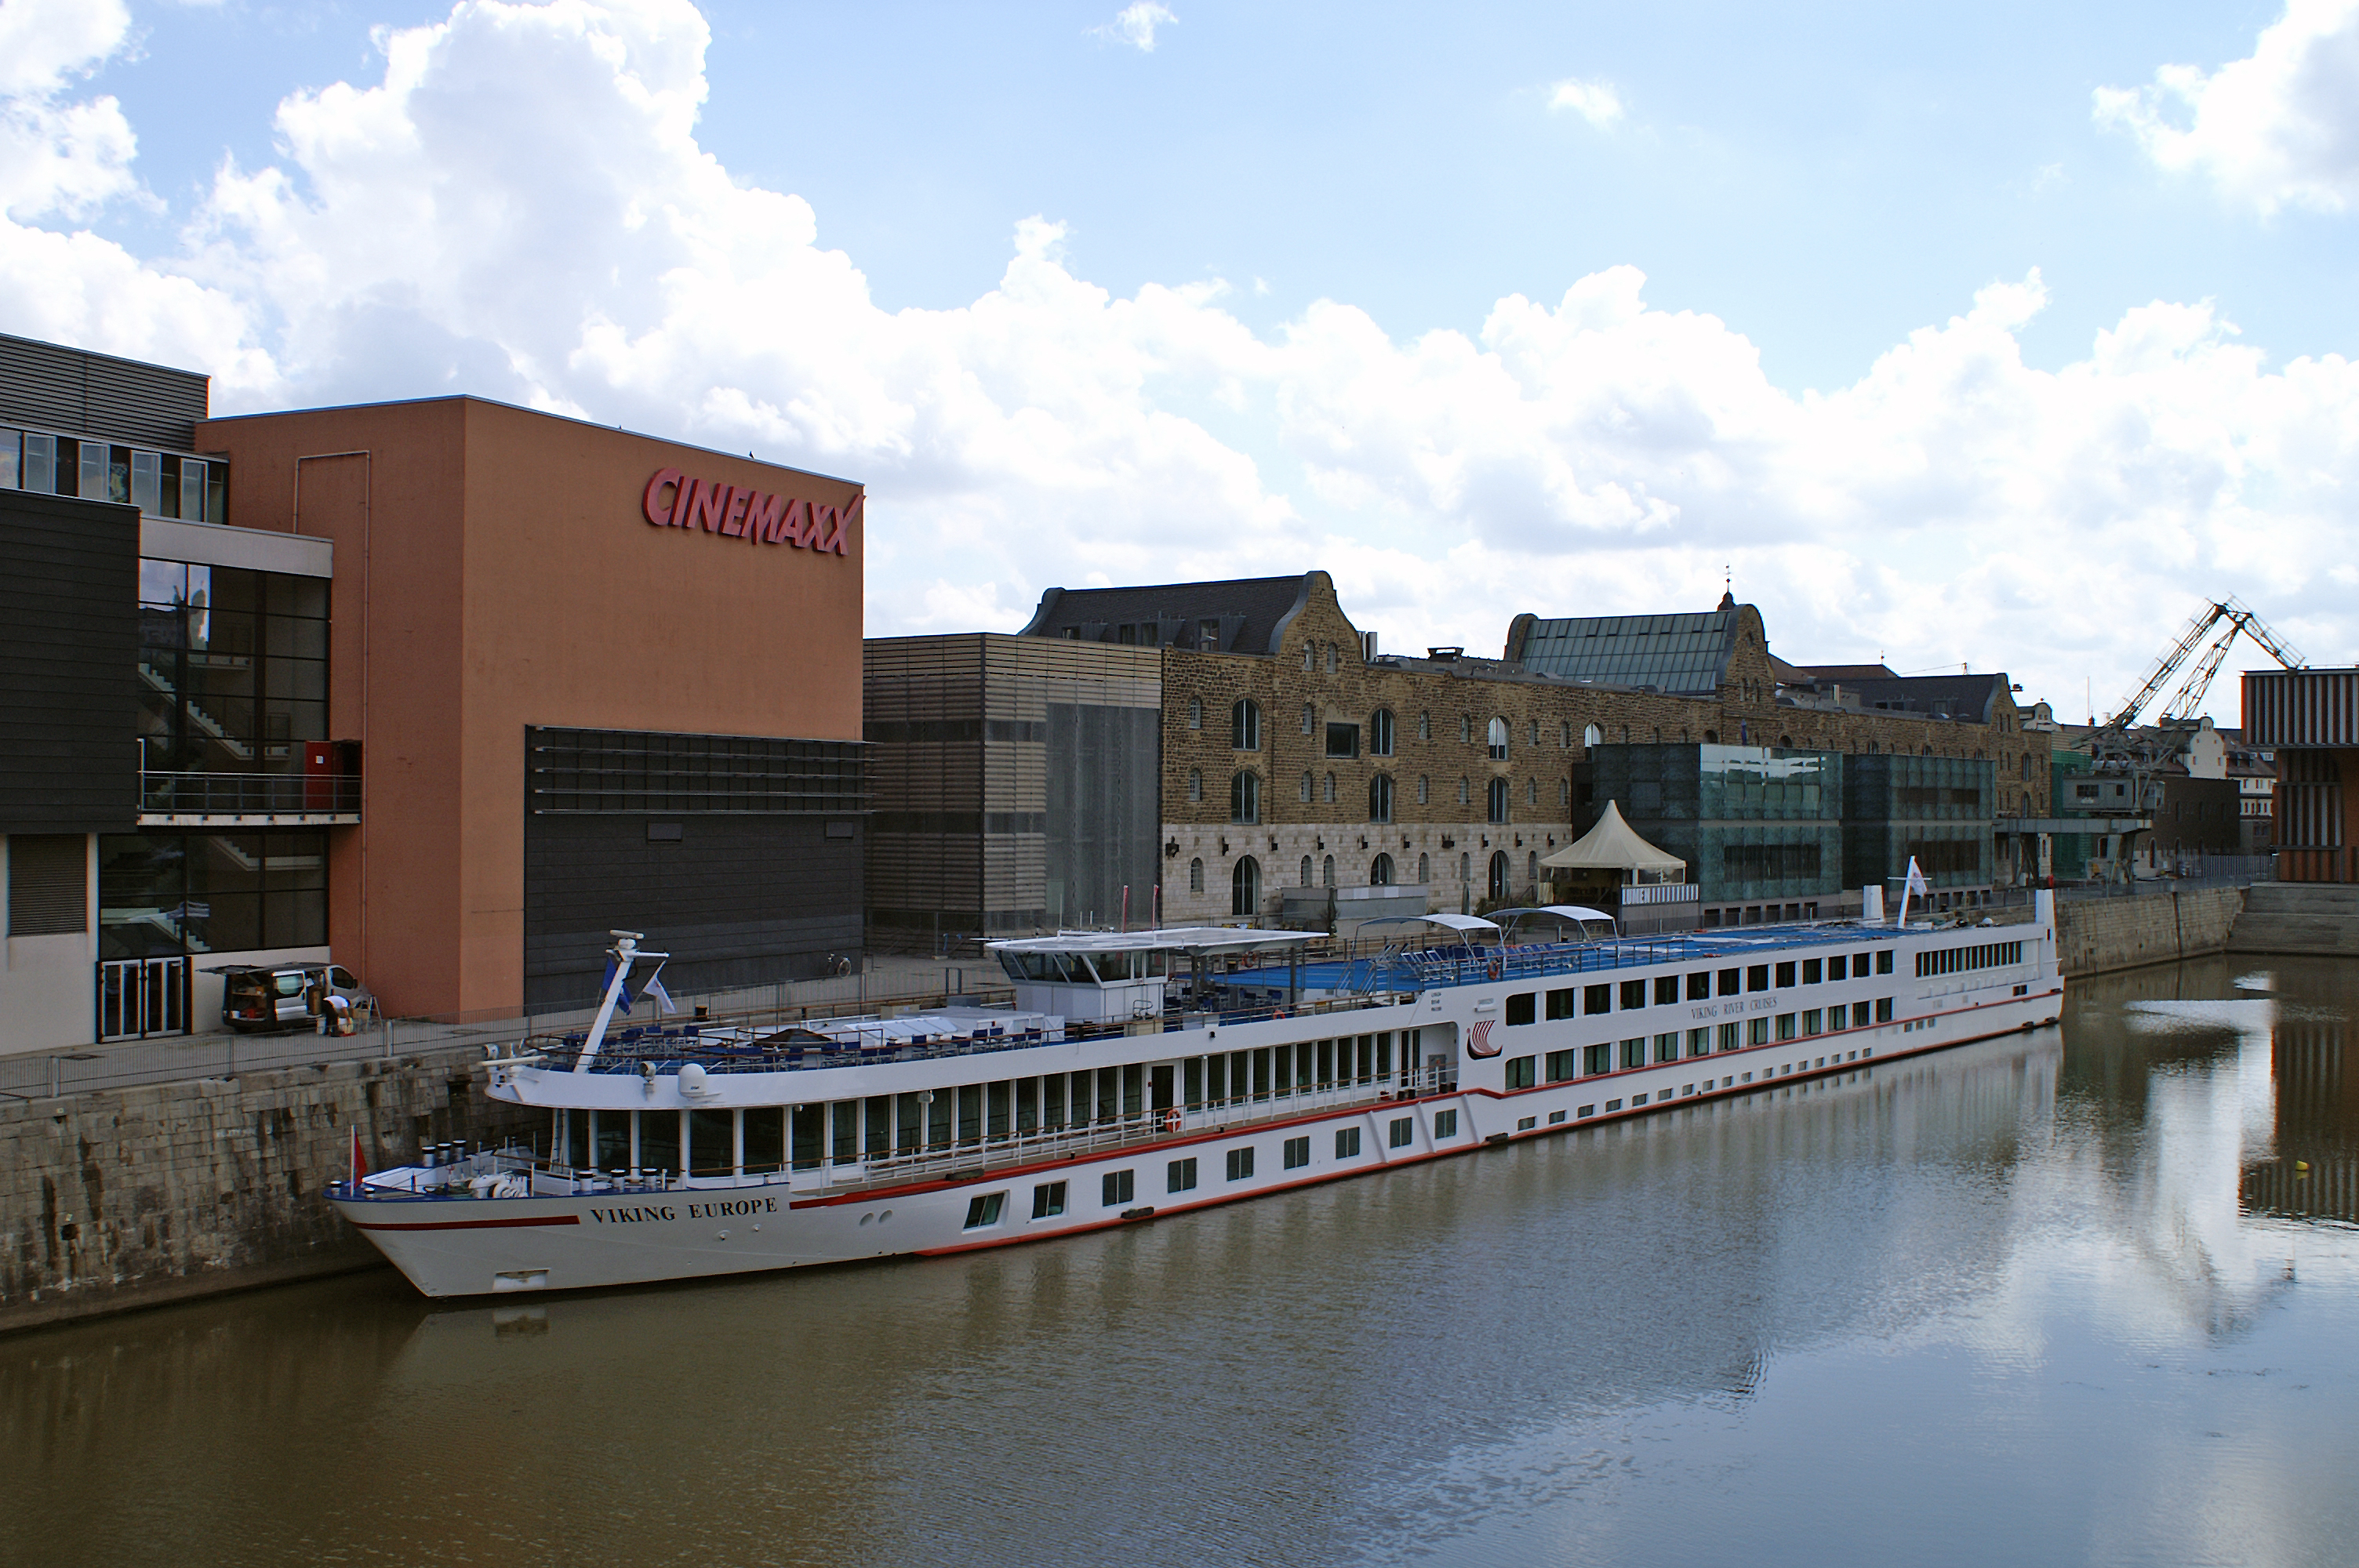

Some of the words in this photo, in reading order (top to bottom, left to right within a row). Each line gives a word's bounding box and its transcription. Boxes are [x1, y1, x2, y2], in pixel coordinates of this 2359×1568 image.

[642, 467, 867, 556] CINEMAXX
[1622, 887, 1651, 906] LUMEN
[1691, 1004, 1717, 1019] VIKING
[1723, 1000, 1744, 1015] RIVER
[1750, 996, 1778, 1011] CRUISES
[591, 1206, 675, 1223] VIKING
[688, 1197, 777, 1218] EUROPE
